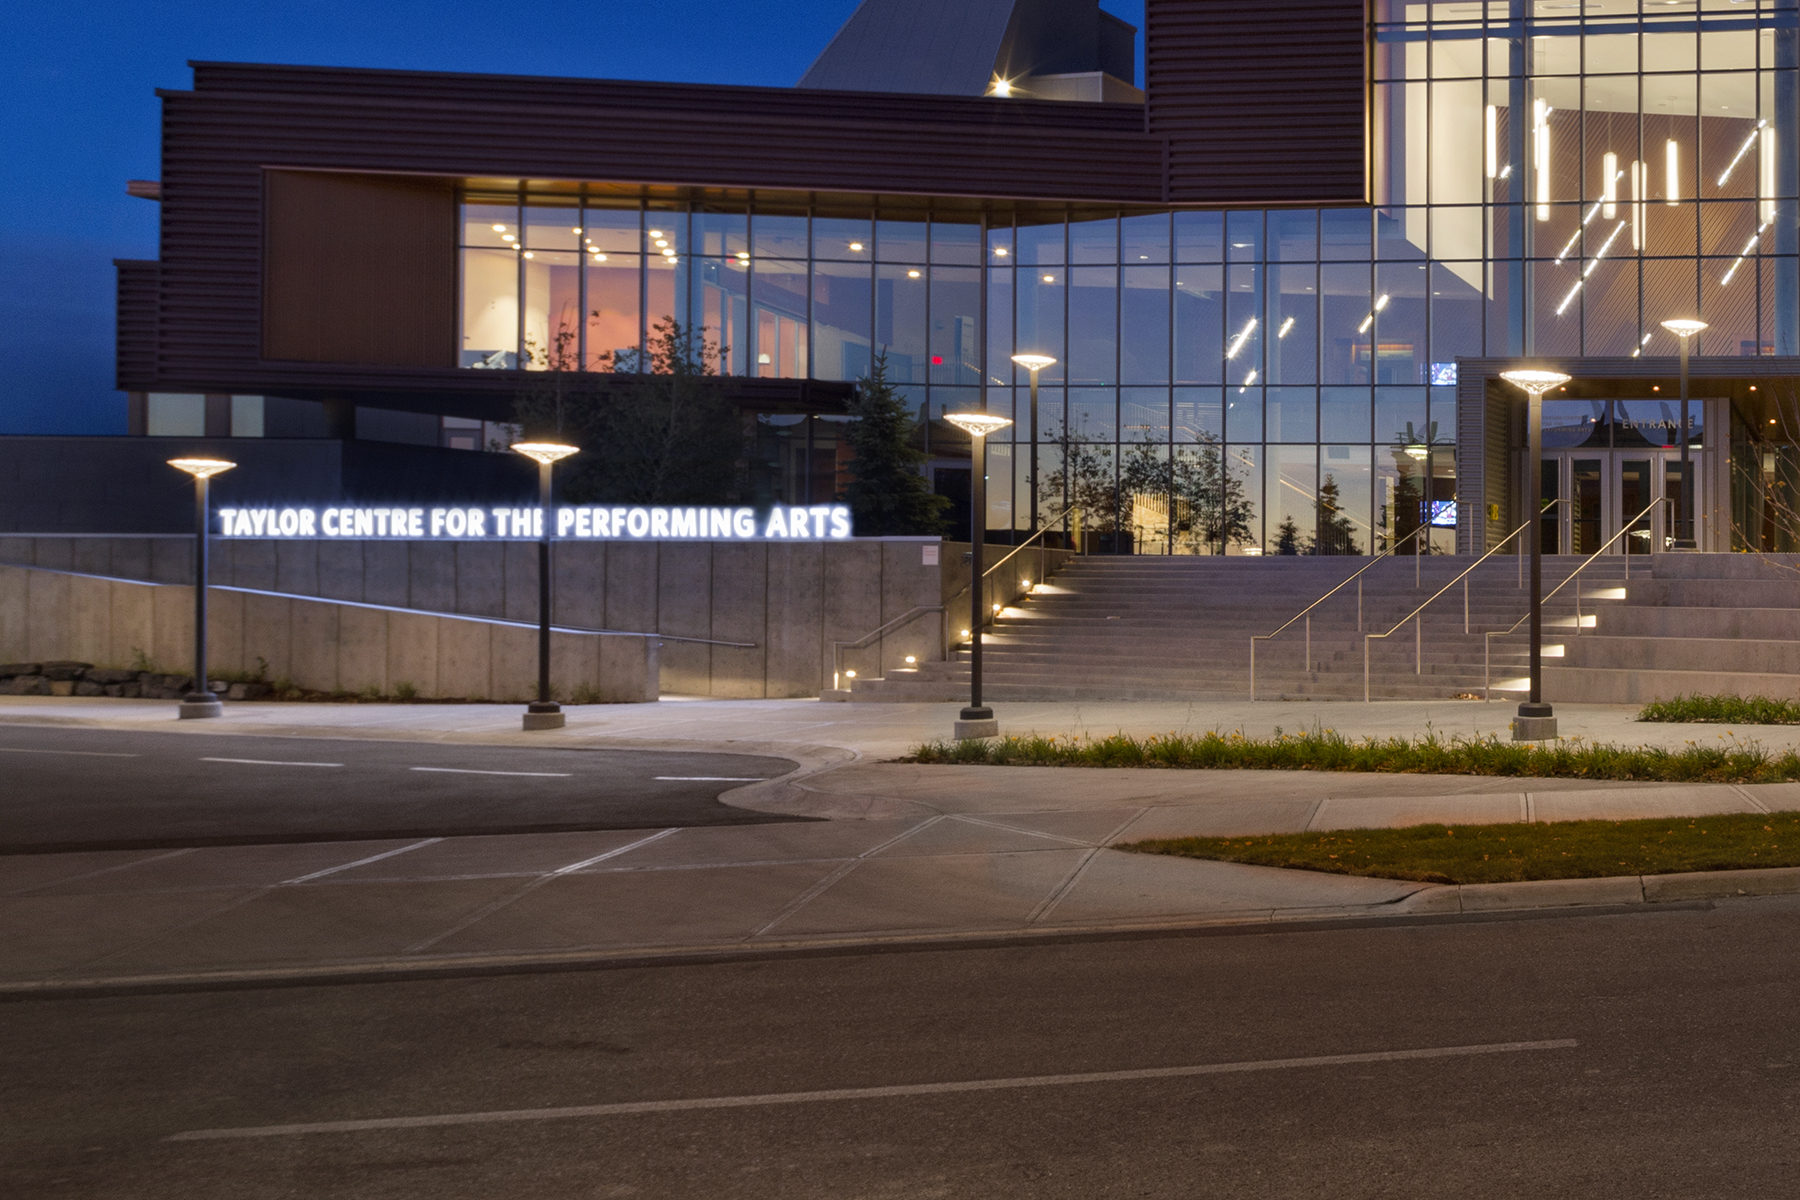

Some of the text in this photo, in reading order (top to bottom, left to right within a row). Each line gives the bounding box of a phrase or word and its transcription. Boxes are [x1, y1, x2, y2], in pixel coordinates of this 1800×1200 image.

[218, 506, 850, 538] TAYLOR CENTRE FOR THE PERFORMING ARTS
